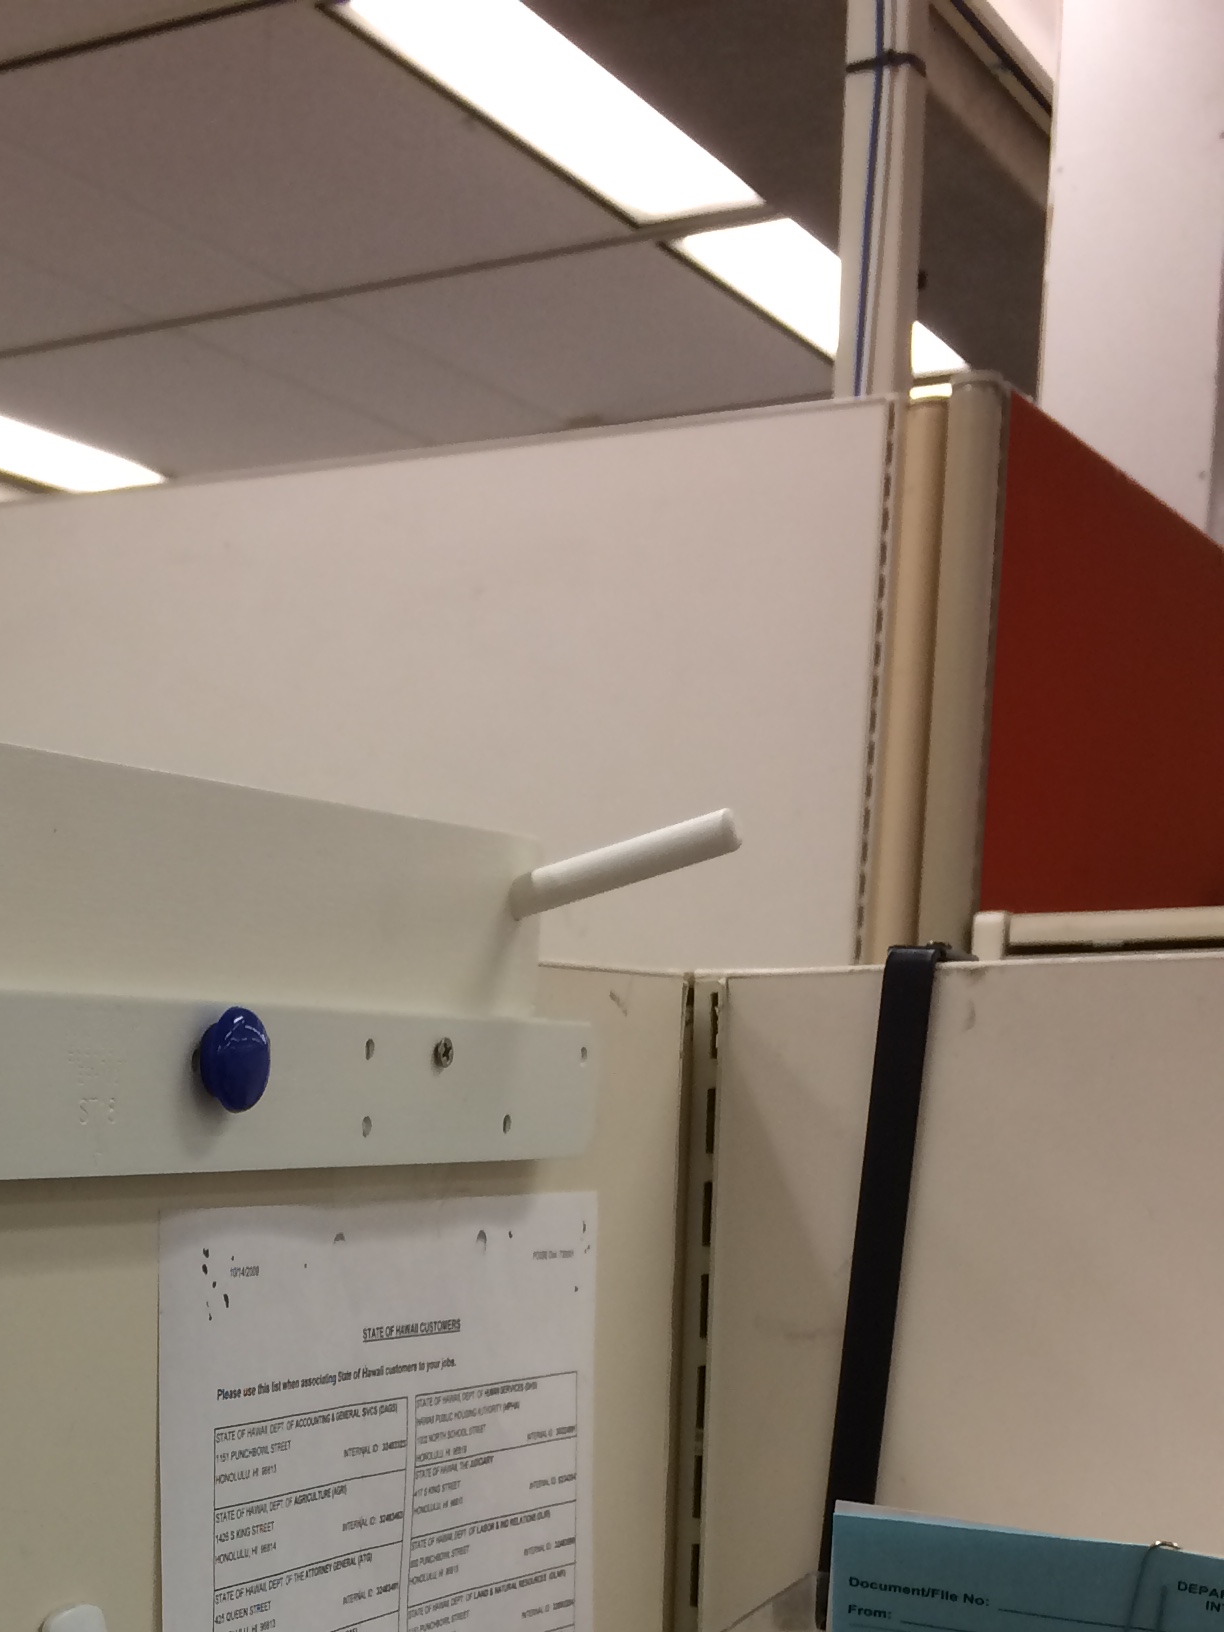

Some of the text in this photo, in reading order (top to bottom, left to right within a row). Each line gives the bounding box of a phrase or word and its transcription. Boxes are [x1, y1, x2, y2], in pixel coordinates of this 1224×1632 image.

[362, 1326, 384, 1341] STATE
[384, 1324, 395, 1338] OF
[419, 1318, 461, 1333] CUSTOMERS
[216, 1357, 457, 1401] Please use this list when associating State of Hawaii customers to your jobs.
[215, 1430, 236, 1444] STATE
[236, 1428, 246, 1440] OF
[215, 1509, 235, 1524] STATE
[235, 1507, 245, 1520] OF
[962, 1593, 990, 1607] No:
[1204, 1600, 1224, 1613] IN
[847, 1604, 892, 1619] From:
